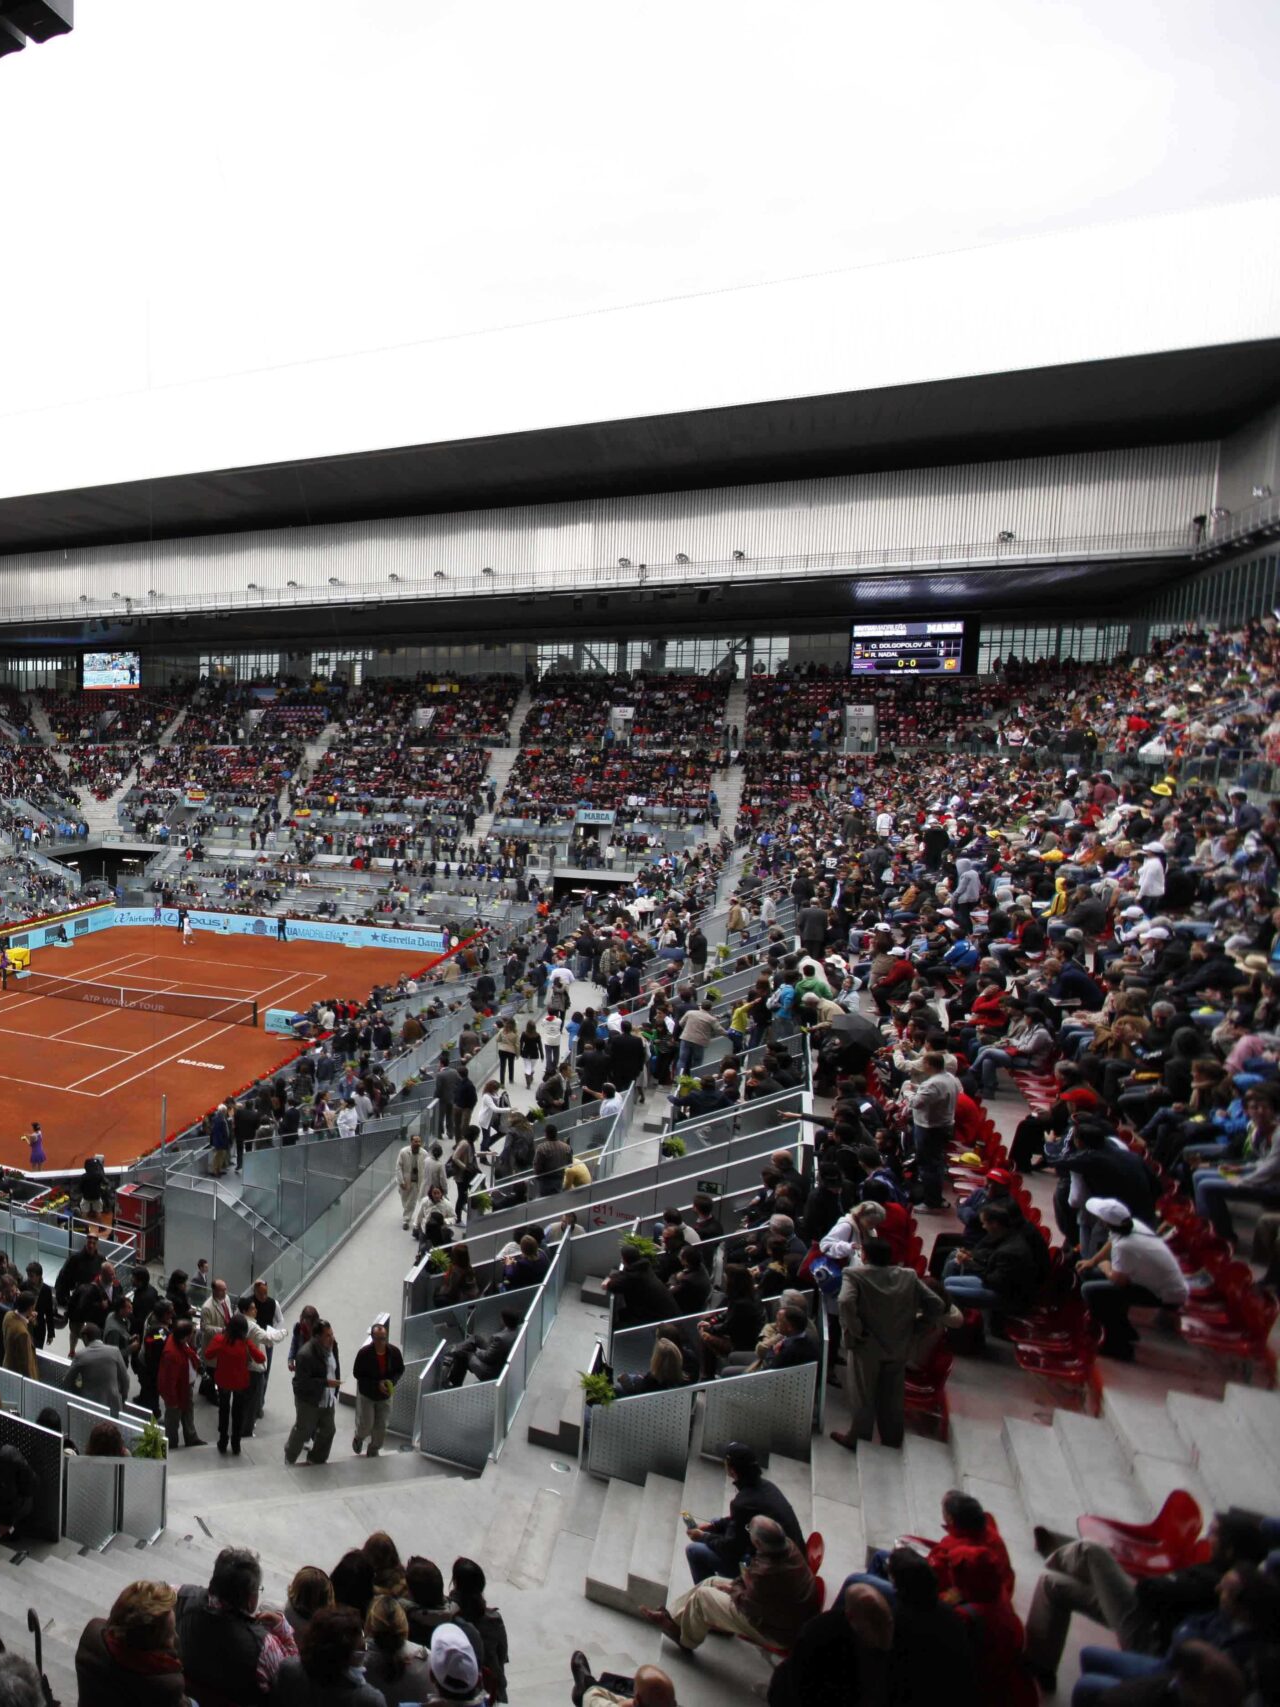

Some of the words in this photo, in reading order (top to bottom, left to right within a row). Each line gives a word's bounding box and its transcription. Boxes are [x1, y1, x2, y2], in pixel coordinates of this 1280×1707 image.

[910, 659, 916, 667] 0
[584, 812, 610, 821] MARCA
[187, 917, 220, 926] EXUS
[380, 933, 417, 946] Estrella
[103, 996, 137, 1009] WORLD
[139, 1002, 165, 1012] TOUR
[177, 1058, 225, 1071] MADRID
[592, 1204, 613, 1216] B11
